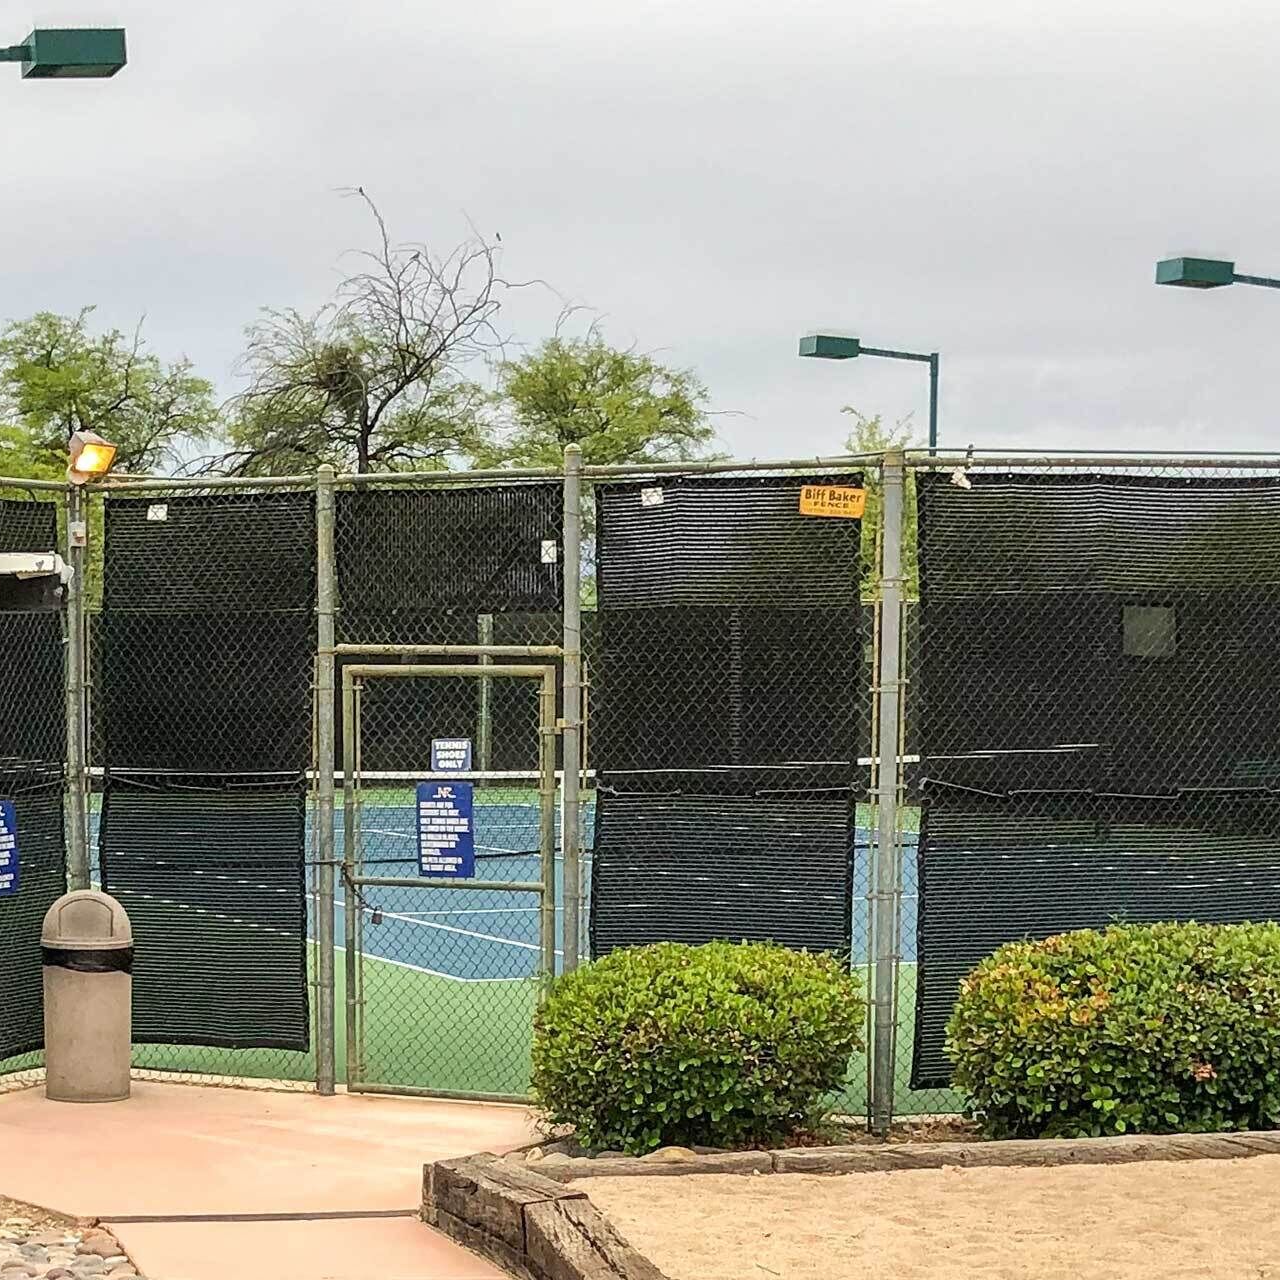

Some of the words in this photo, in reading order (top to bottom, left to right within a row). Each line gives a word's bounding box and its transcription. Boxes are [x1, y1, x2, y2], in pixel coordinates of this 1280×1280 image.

[805, 489, 825, 501] Biff
[828, 489, 862, 503] Baker
[813, 501, 849, 509] FENCE
[435, 741, 468, 750] TENNIS
[436, 750, 466, 760] SHOES
[438, 759, 464, 769] ONLY
